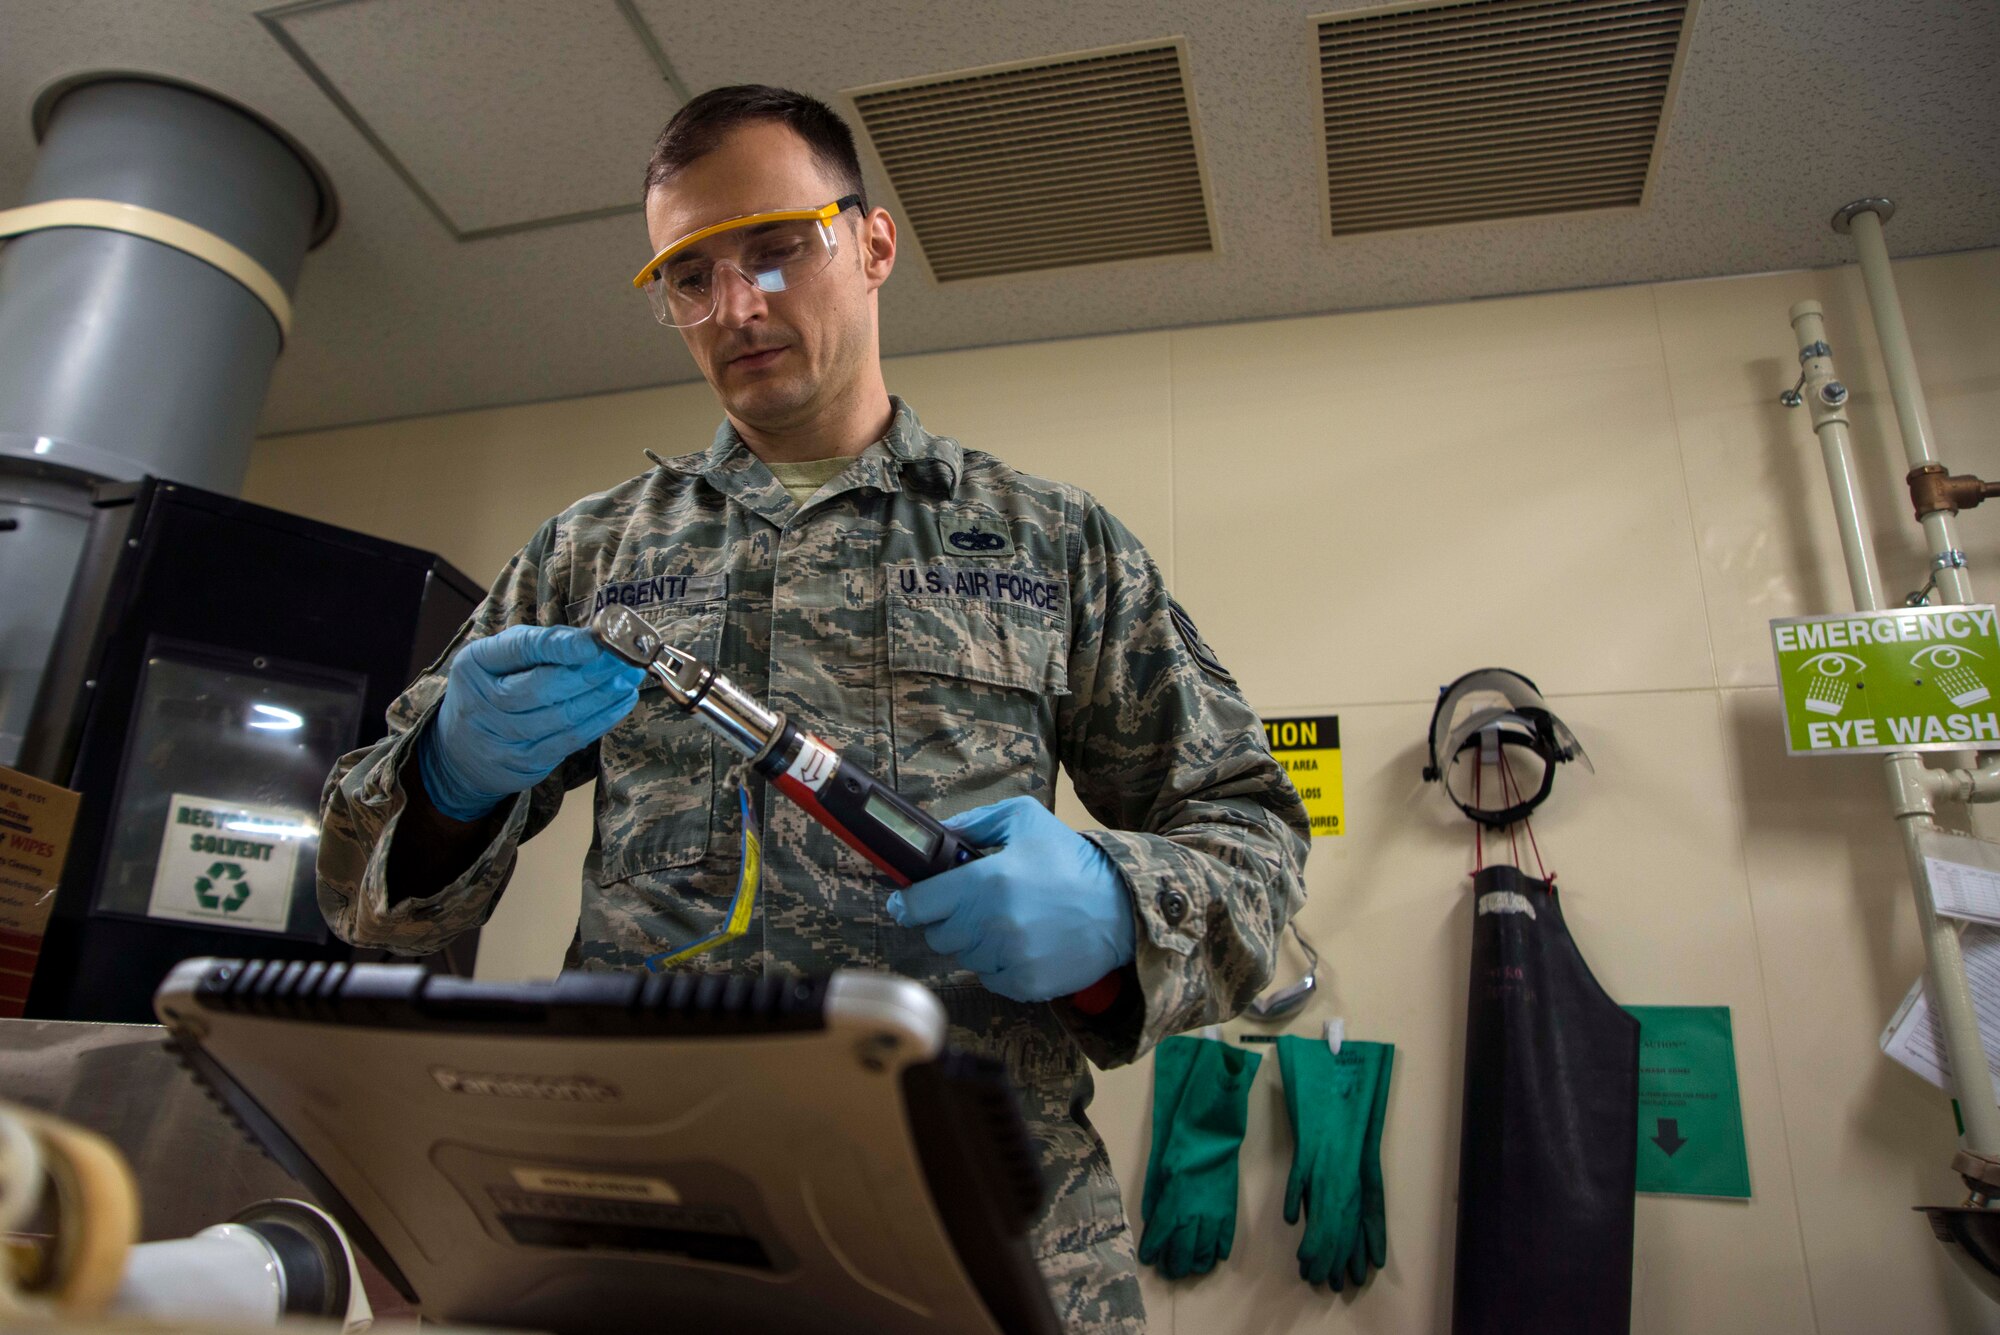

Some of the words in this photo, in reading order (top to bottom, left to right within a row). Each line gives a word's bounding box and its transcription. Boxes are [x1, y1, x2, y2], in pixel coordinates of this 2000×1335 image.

[595, 576, 688, 613] ARGENTI
[900, 569, 949, 594] U.S.
[955, 571, 991, 597] AIR
[996, 573, 1059, 611] FORCE
[1775, 611, 1992, 651] EMERGENCY
[1807, 718, 1879, 749] EYE
[1886, 712, 2000, 743] WASH
[1292, 759, 1319, 771] AREA
[1301, 788, 1322, 799] LOSS
[10, 834, 55, 859] WIPES
[190, 833, 274, 862] SOLVENT
